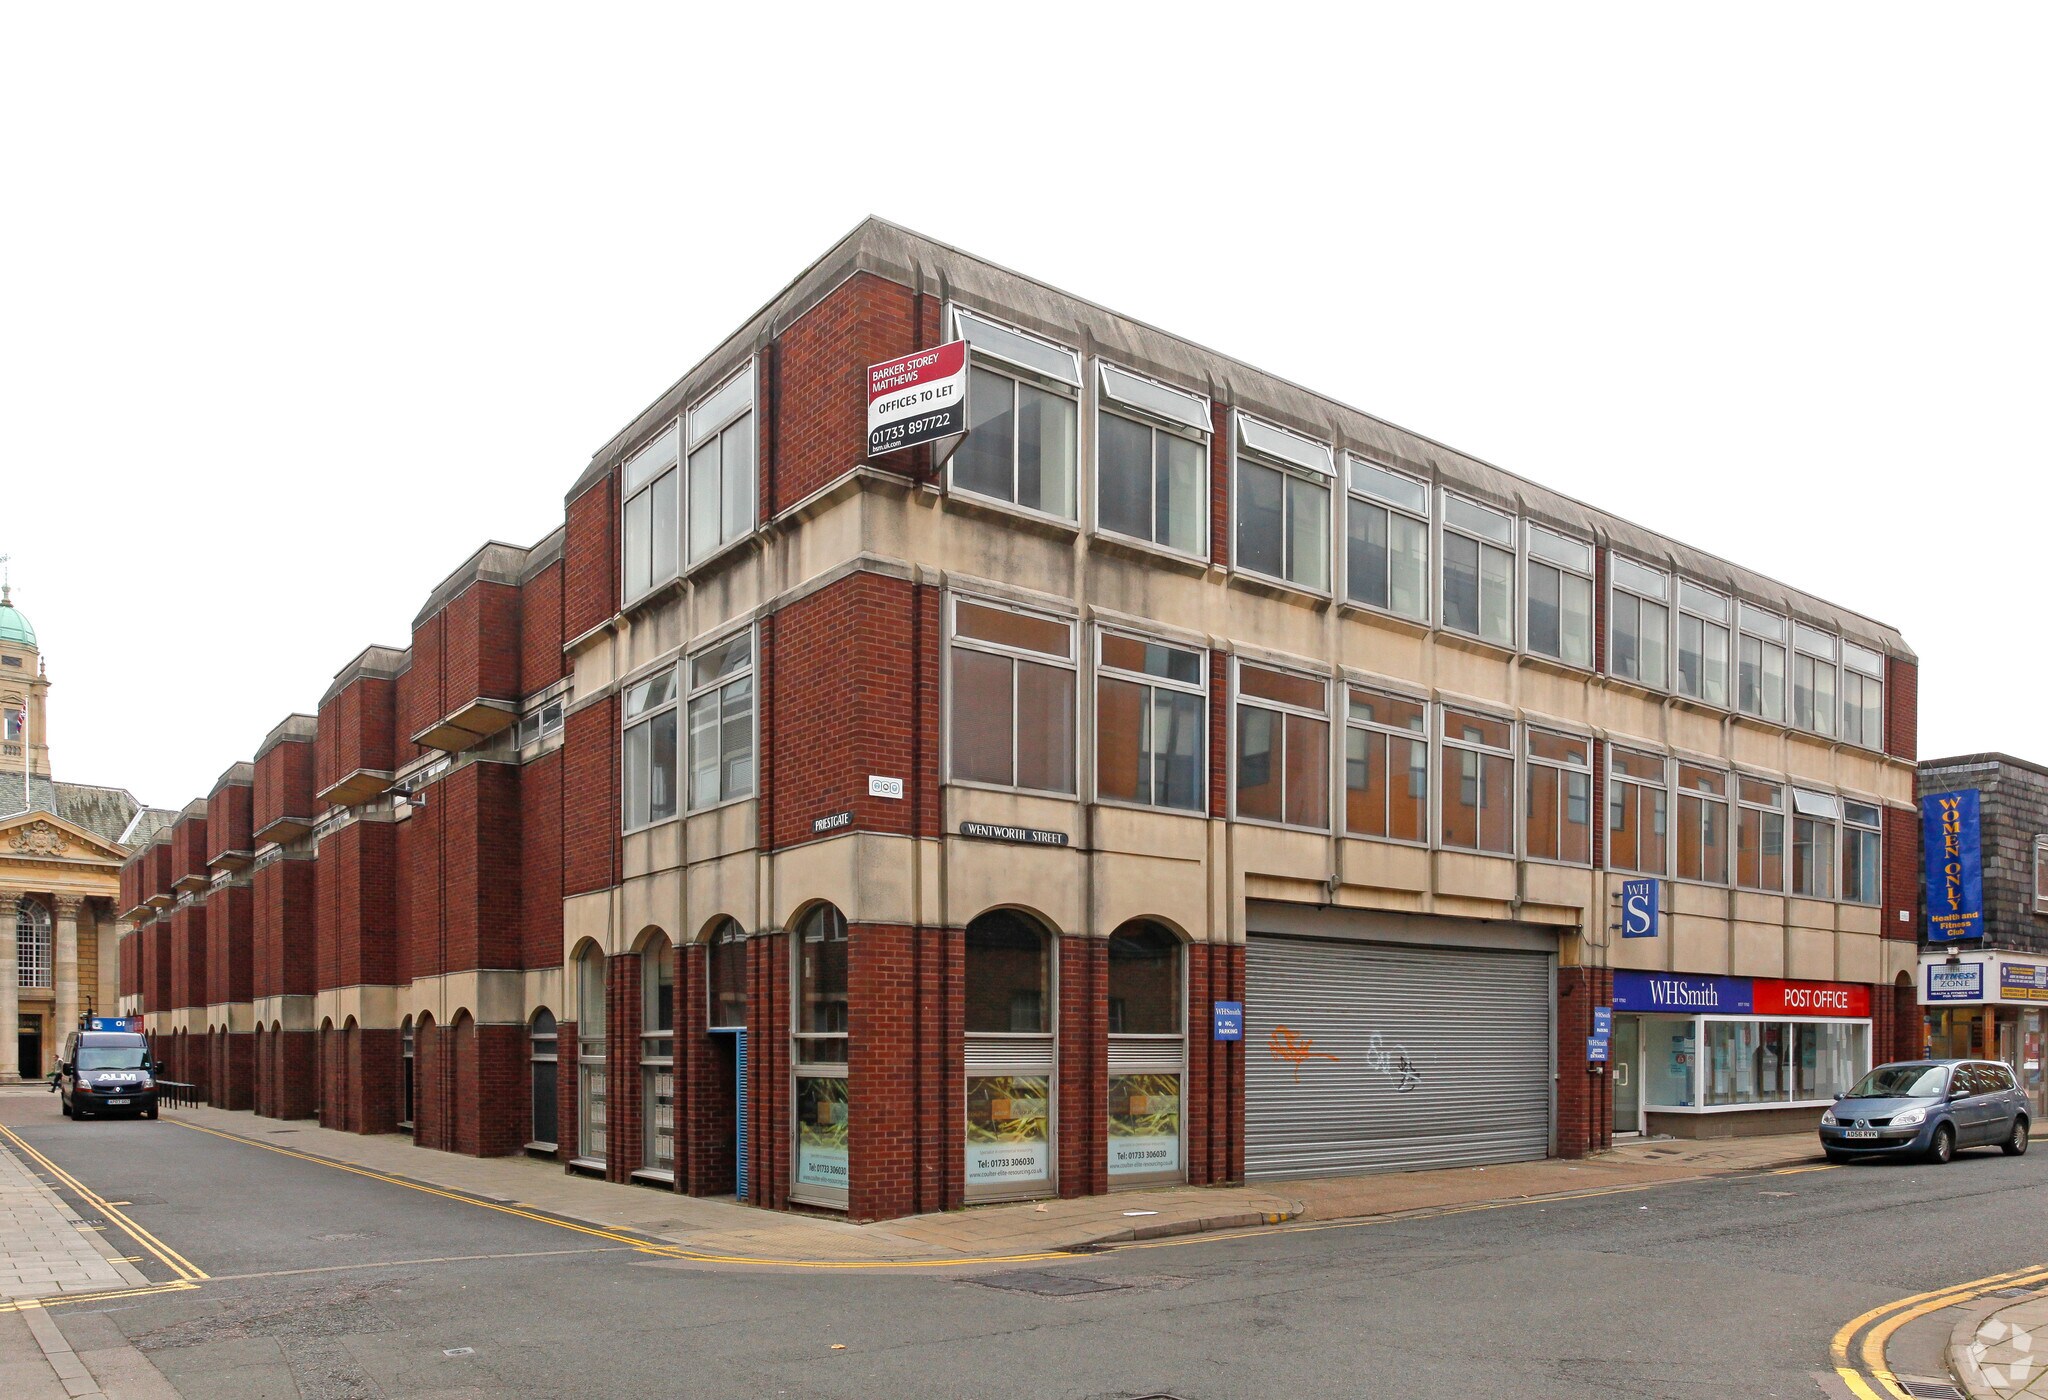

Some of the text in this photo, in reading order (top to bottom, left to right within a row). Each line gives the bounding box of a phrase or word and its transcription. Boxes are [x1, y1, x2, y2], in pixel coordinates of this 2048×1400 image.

[872, 353, 939, 381] BARKER STOREY
[872, 370, 918, 393] MATTHEWS
[878, 384, 954, 414] OFFICES TO LET
[872, 413, 950, 444] 01733 897722
[872, 440, 902, 453] bsm.uk.com
[815, 812, 850, 833] PRIESTGATE
[968, 823, 1062, 844] WENTWORTH STREET
[1939, 796, 1962, 911] WOMEN ONLY
[1627, 883, 1649, 895] WH
[1626, 895, 1650, 933] S
[1932, 911, 1979, 922] Health and
[1940, 921, 1972, 929] Fitness
[1934, 972, 1977, 980] FITNESS
[1650, 979, 1719, 1007] WHSmith
[1784, 988, 1848, 1009] POST OFFICE
[98, 1073, 137, 1081] ALM
[978, 1157, 1035, 1168] Tel: 01733 306030
[1117, 1150, 1167, 1160] Tel: 01733 306030
[809, 1163, 847, 1175] Tel: 01733 306030
[969, 1169, 1043, 1179] www.coulter-elite-resourcing.co.uk
